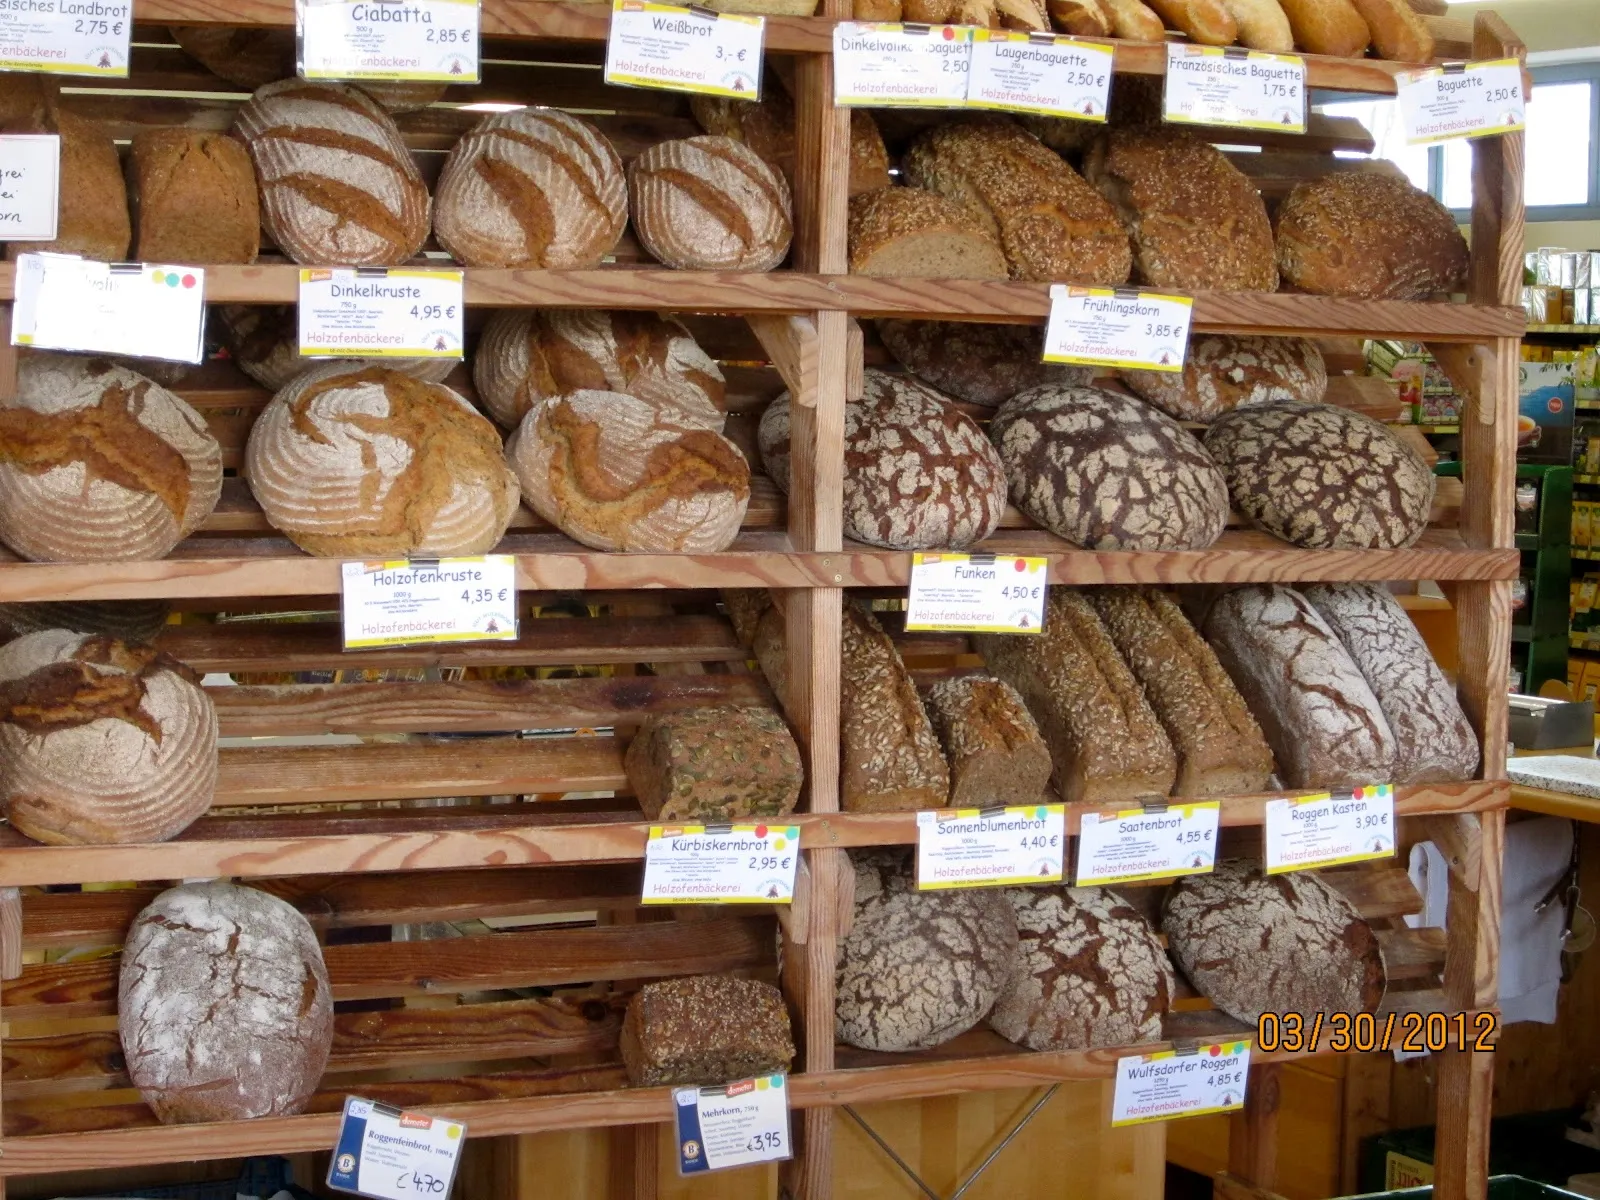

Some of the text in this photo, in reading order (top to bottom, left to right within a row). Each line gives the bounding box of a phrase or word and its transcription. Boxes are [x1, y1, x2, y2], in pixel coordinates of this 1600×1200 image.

[59, 0, 128, 18] Landbrot
[352, 4, 432, 23] Ciabatta
[75, 19, 123, 36] 2,75 €
[652, 17, 713, 37] Weißbrot
[426, 28, 471, 44] 2,85 €
[737, 48, 747, 62] €
[995, 43, 1088, 67] Laugenbaguette
[942, 60, 969, 76] 2,50
[1169, 56, 1301, 81] Französisches Baguette
[1067, 71, 1105, 87] 2,50 €
[1437, 76, 1484, 94] Baguette
[1263, 83, 1297, 98] 1,75 €
[1486, 86, 1518, 103] 2,50 €
[331, 284, 421, 298] Dinkelkruste
[410, 305, 455, 321] 4,95 €
[1082, 298, 1160, 317] Frühlingskorn
[307, 331, 404, 344] Holzofenbäckerei
[1145, 323, 1170, 338] 3,85
[1173, 326, 1182, 338] €
[373, 567, 482, 587] Holzofenkruste
[954, 566, 996, 579] Funken
[461, 588, 507, 604] 4,35 €
[1001, 586, 1040, 600] 4,50 €
[914, 610, 995, 621] Holzofenbäckerei
[362, 618, 456, 635] Holzofenbäckerei
[1292, 801, 1367, 822] Roggen Kasten
[937, 818, 1046, 835] Sonnenblumenbrot
[1118, 817, 1182, 834] Saatenbrot
[1355, 813, 1388, 830] 3,90 €
[671, 838, 769, 852] Kürbiskernbrot
[1020, 835, 1058, 851] 4,40 €
[1175, 829, 1212, 845] 4,55 €
[748, 857, 778, 871] 2,95
[781, 857, 791, 869] €
[934, 864, 1016, 878] Holzofenbäckerei
[653, 883, 741, 895] Holzofenbäckerei
[1128, 1056, 1239, 1080] Wulfsdorfer Roggen
[1207, 1071, 1243, 1088] 4,85 €
[727, 1083, 753, 1096] demeter
[701, 1106, 743, 1119] Mehrkorn,
[1126, 1097, 1201, 1116] Holzofenbäckerei
[401, 1115, 429, 1128] demeter
[367, 1129, 432, 1154] Roggenfeinbrot,
[343, 1158, 350, 1168] B
[412, 1169, 445, 1193] 4,70
